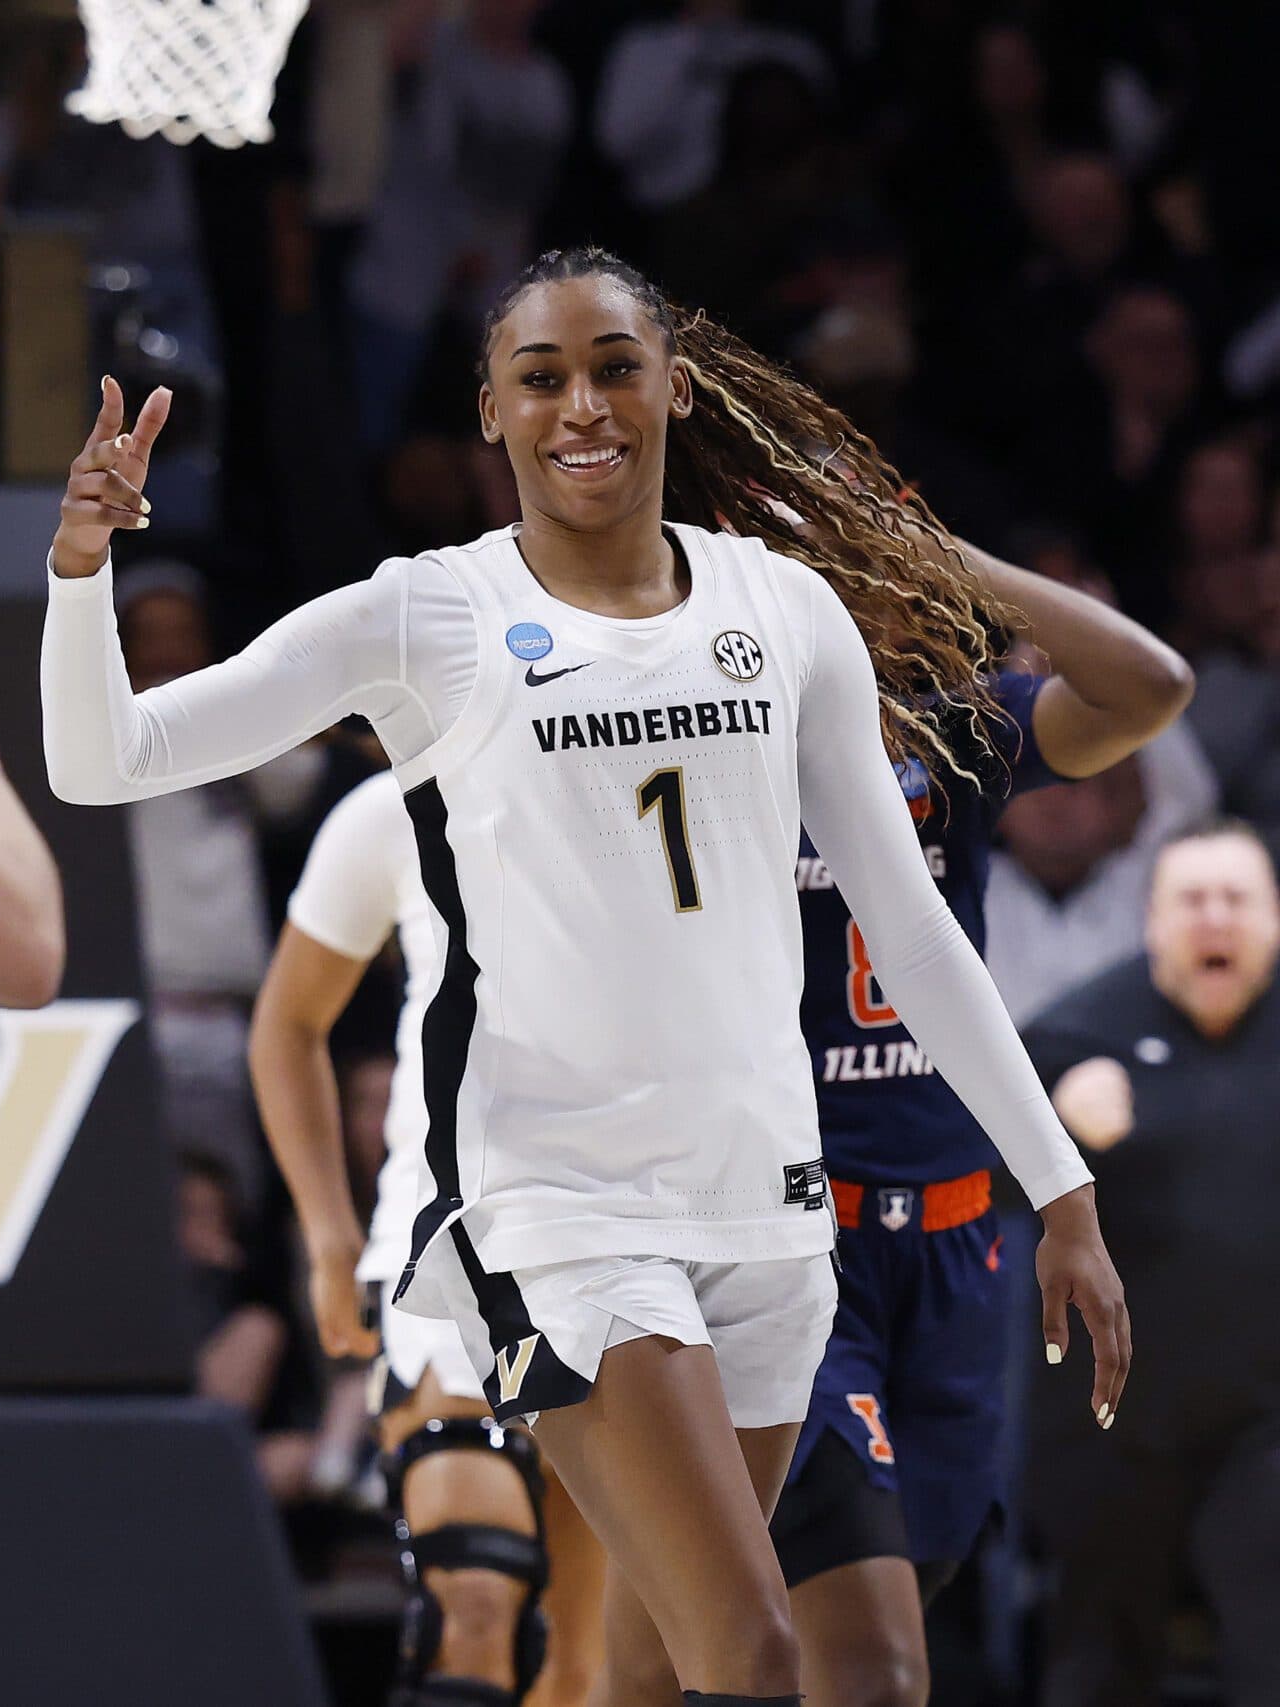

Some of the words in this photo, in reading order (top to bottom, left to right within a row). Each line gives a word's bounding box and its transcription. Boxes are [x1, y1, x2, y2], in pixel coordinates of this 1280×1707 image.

[714, 631, 762, 679] SEC
[532, 700, 771, 752] VANDERBILT
[635, 765, 703, 913] 1
[496, 1331, 542, 1404] V
